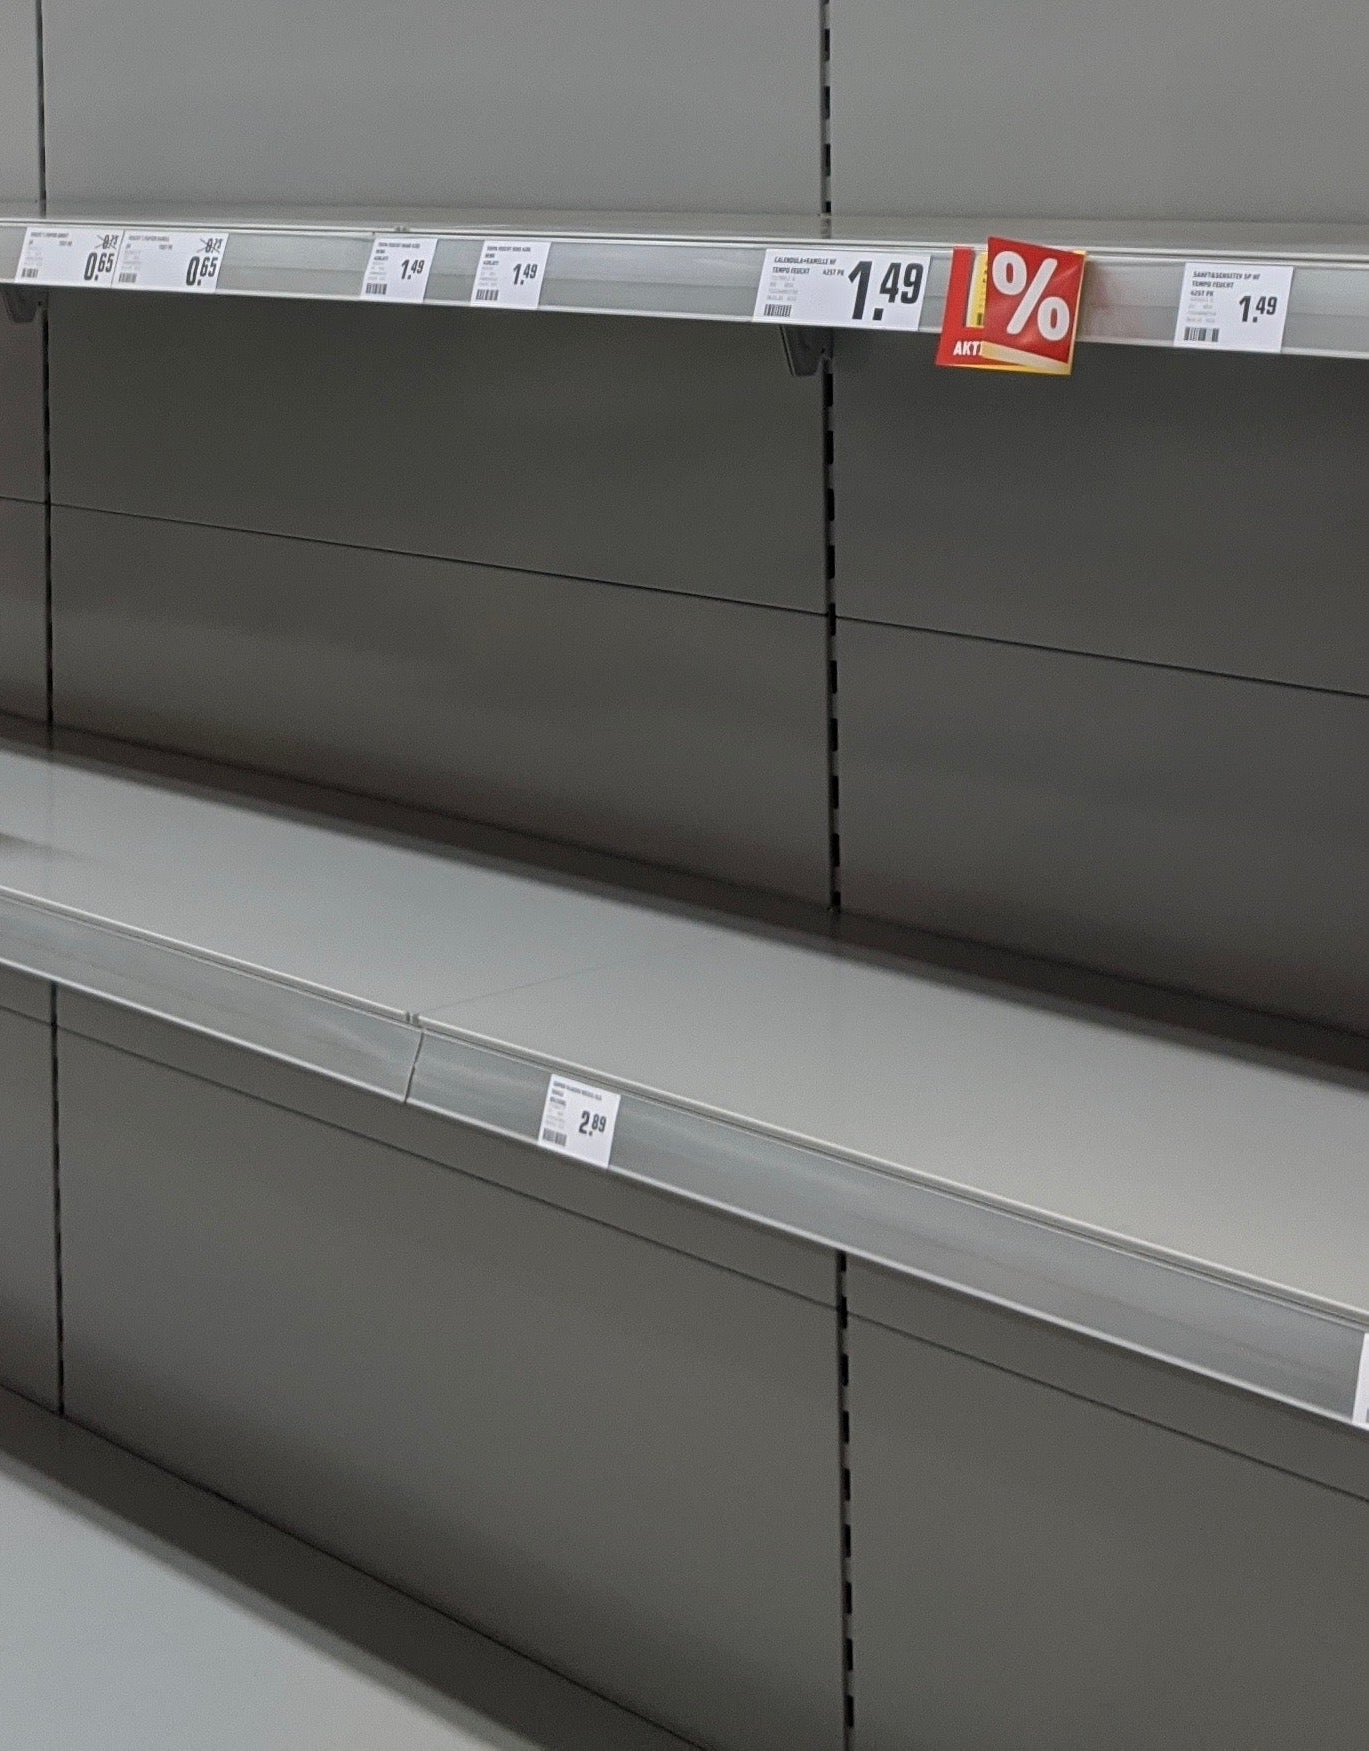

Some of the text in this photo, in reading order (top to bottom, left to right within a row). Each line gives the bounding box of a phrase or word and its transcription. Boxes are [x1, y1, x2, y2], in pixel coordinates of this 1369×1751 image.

[84, 252, 115, 281] 0.65
[186, 256, 218, 286] 0.65
[401, 259, 425, 280] 1.49
[513, 263, 538, 286] 1.49
[772, 266, 790, 274] TEMPO
[790, 267, 810, 275] FEUCHT
[848, 260, 924, 321] 1.49
[1239, 295, 1278, 323] 1.49
[578, 1110, 607, 1137] 2.89
